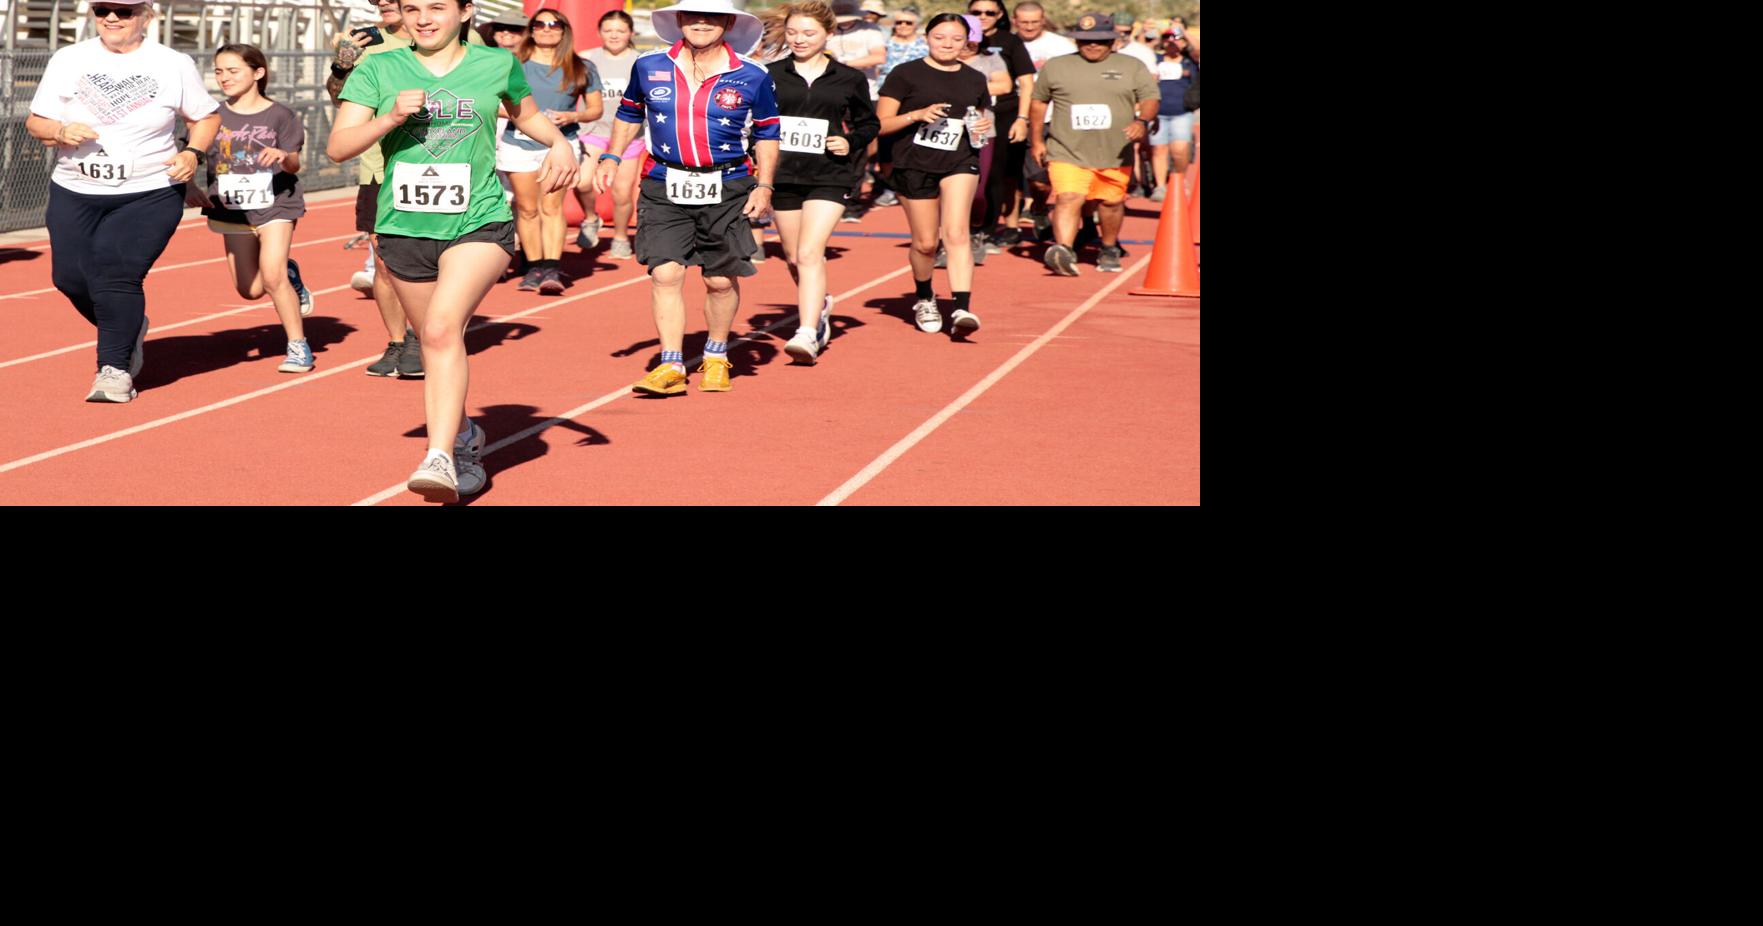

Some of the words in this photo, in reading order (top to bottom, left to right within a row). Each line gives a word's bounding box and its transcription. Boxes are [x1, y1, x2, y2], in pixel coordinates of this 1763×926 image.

[88, 73, 117, 95] HEART
[114, 75, 138, 92] WALK
[110, 93, 132, 107] HOPE
[1075, 115, 1106, 126] 1627
[781, 131, 822, 149] 1603
[919, 128, 959, 146] 1637
[78, 161, 127, 180] 1631
[224, 189, 269, 205] 1571
[399, 184, 465, 206] 1573
[670, 182, 717, 199] 1634
